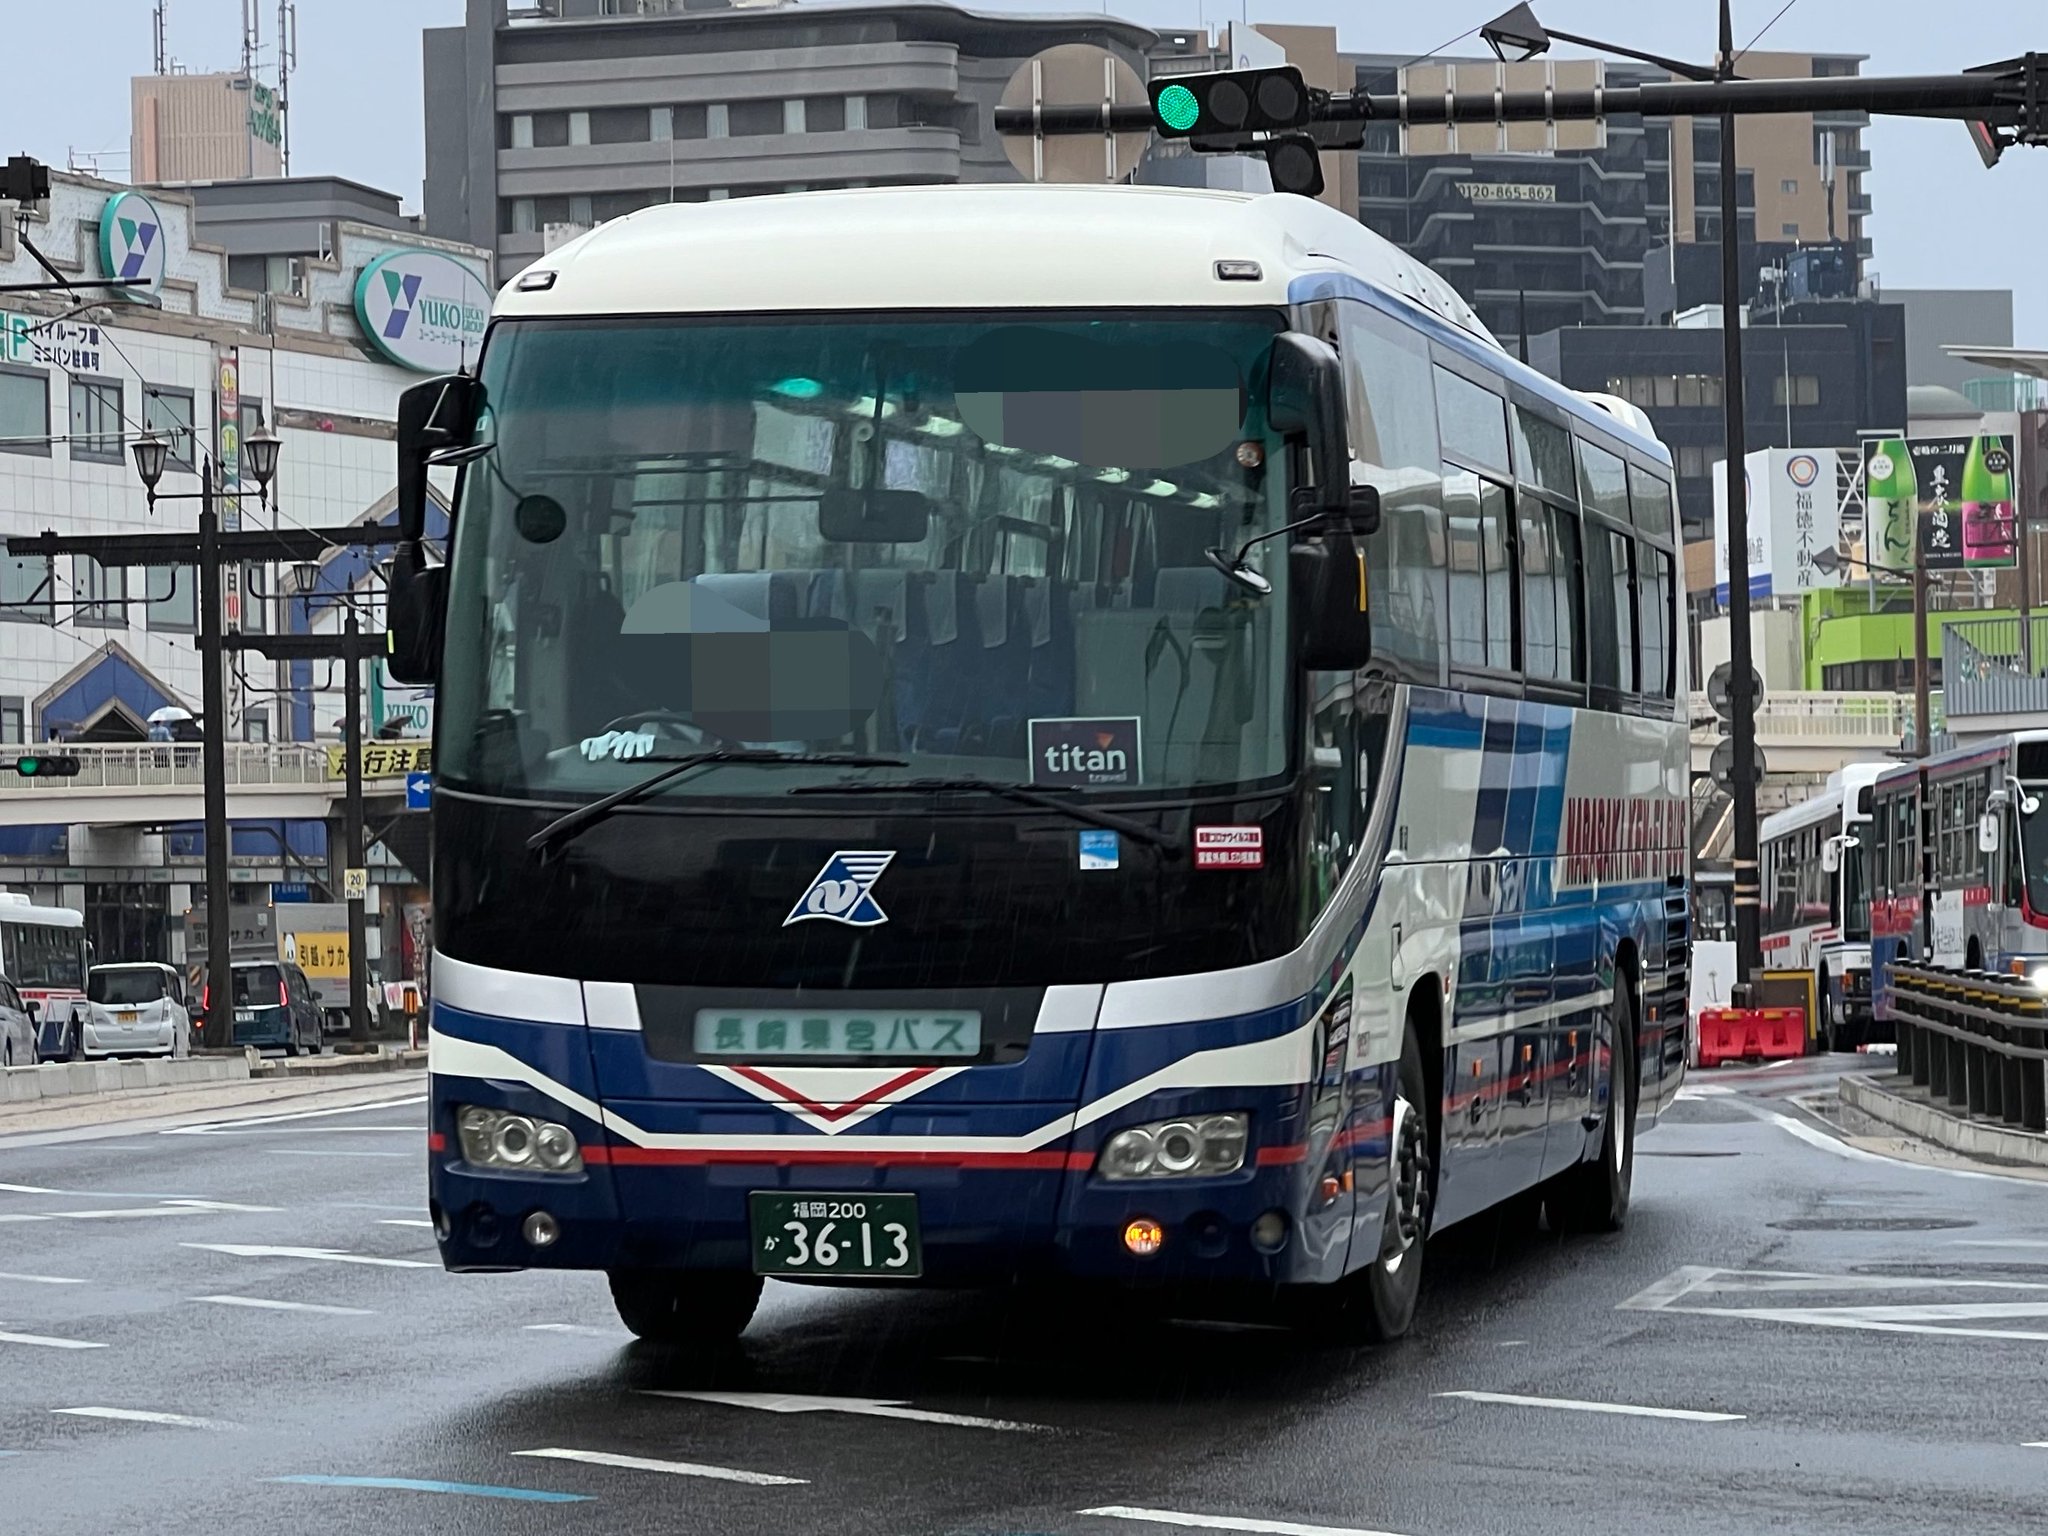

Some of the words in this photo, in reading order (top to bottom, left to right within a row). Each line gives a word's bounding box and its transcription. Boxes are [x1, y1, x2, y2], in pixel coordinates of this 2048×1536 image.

[1459, 183, 1554, 200] 0120-865-862
[418, 299, 461, 330] YUKO
[12, 318, 28, 357] P
[1795, 490, 1815, 588] 福徳不動産
[1044, 742, 1126, 773] titan
[1566, 797, 1626, 885] NAGASAKI
[350, 874, 361, 885] 20
[714, 1017, 966, 1051] 長崎県営バス
[792, 1201, 867, 1219] 福岡200
[763, 1235, 780, 1251] か
[783, 1220, 909, 1268] 36-13
